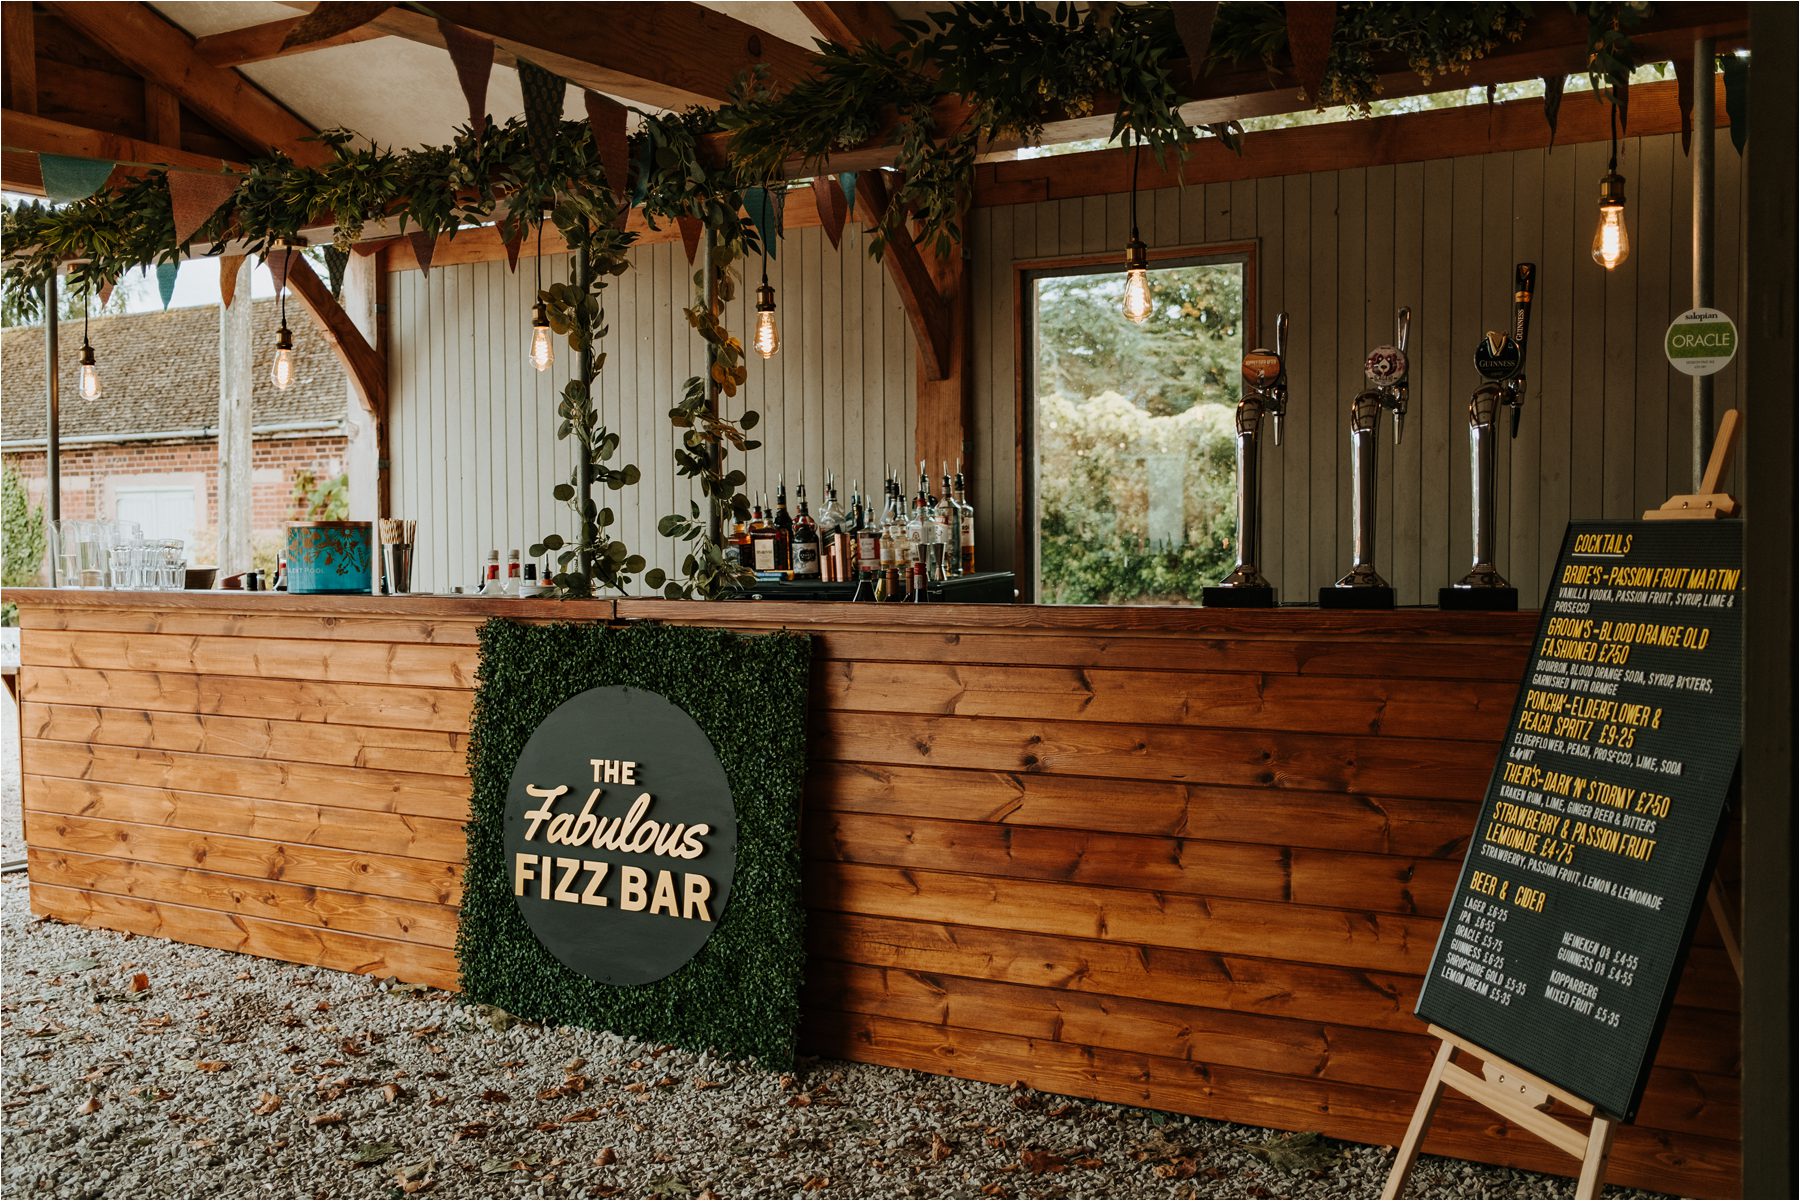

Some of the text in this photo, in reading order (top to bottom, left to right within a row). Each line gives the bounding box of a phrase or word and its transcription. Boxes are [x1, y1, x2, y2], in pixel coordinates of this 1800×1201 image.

[1515, 308, 1524, 341] GUINNESS
[1685, 312, 1718, 322] salopian
[1672, 333, 1730, 348] ORACLE
[1479, 359, 1516, 368] GUINNESS
[1574, 534, 1633, 554] COCKTAILS
[1652, 567, 1690, 589] FRUIT
[1687, 568, 1740, 591] MARTINI
[1554, 600, 1590, 614] PROSECCO
[1559, 587, 1734, 608] VANILLA VODKA, PASSION FRUIT, SYRUP, LIME &
[1540, 638, 1598, 662] FASHIONED
[1636, 623, 1684, 647] ORANGE
[1682, 627, 1710, 650] OLD
[1532, 673, 1619, 696] GARNISHED WITH ORANGE
[1536, 659, 1569, 676] BOURBON,
[1570, 663, 1594, 678] BLOOD
[1594, 666, 1624, 681] ORANGE
[1623, 669, 1646, 686] SODA,
[1647, 672, 1675, 689] SYRUP,
[1518, 710, 1554, 735] PEACH
[1554, 716, 1594, 742] SPRITZ
[1651, 708, 1663, 730] &
[1510, 746, 1516, 758] &
[1514, 732, 1682, 776] ELDERFLOWER, PEACH, PROSECCO, LIME, SODA
[590, 758, 636, 785] THE
[1587, 780, 1636, 809] STORMY
[523, 784, 709, 860] Fabulous
[1500, 784, 1657, 834] KRAKEN RUM, LIME, GINGER BEER & BITTERS
[1485, 822, 1541, 854] LEMONADE
[1492, 801, 1657, 862] STRAWBERRY & PASSION FRUIT
[515, 852, 711, 922] FIZZ BAR
[1480, 843, 1664, 911] STRAWBERRY, PASSION FRUIT, LEMON & LEMONADE
[1464, 895, 1487, 914] LAGER
[1469, 870, 1546, 913] BEER & CIDER
[1458, 910, 1472, 924] IPA
[1455, 923, 1481, 943] ORACLE
[1561, 931, 1600, 956] HEINEKEN
[1450, 938, 1482, 960] GUINNESS
[1557, 947, 1594, 971] GUINNESS
[1441, 965, 1466, 985] LEMON
[1464, 975, 1489, 997] DREAM
[1446, 951, 1486, 978] SHROPSHIRE
[1485, 968, 1505, 986] GOLD
[1549, 969, 1599, 1000] KOPPARBERG
[1544, 985, 1570, 1006] MIXED
[1569, 995, 1595, 1015] FRUIT
